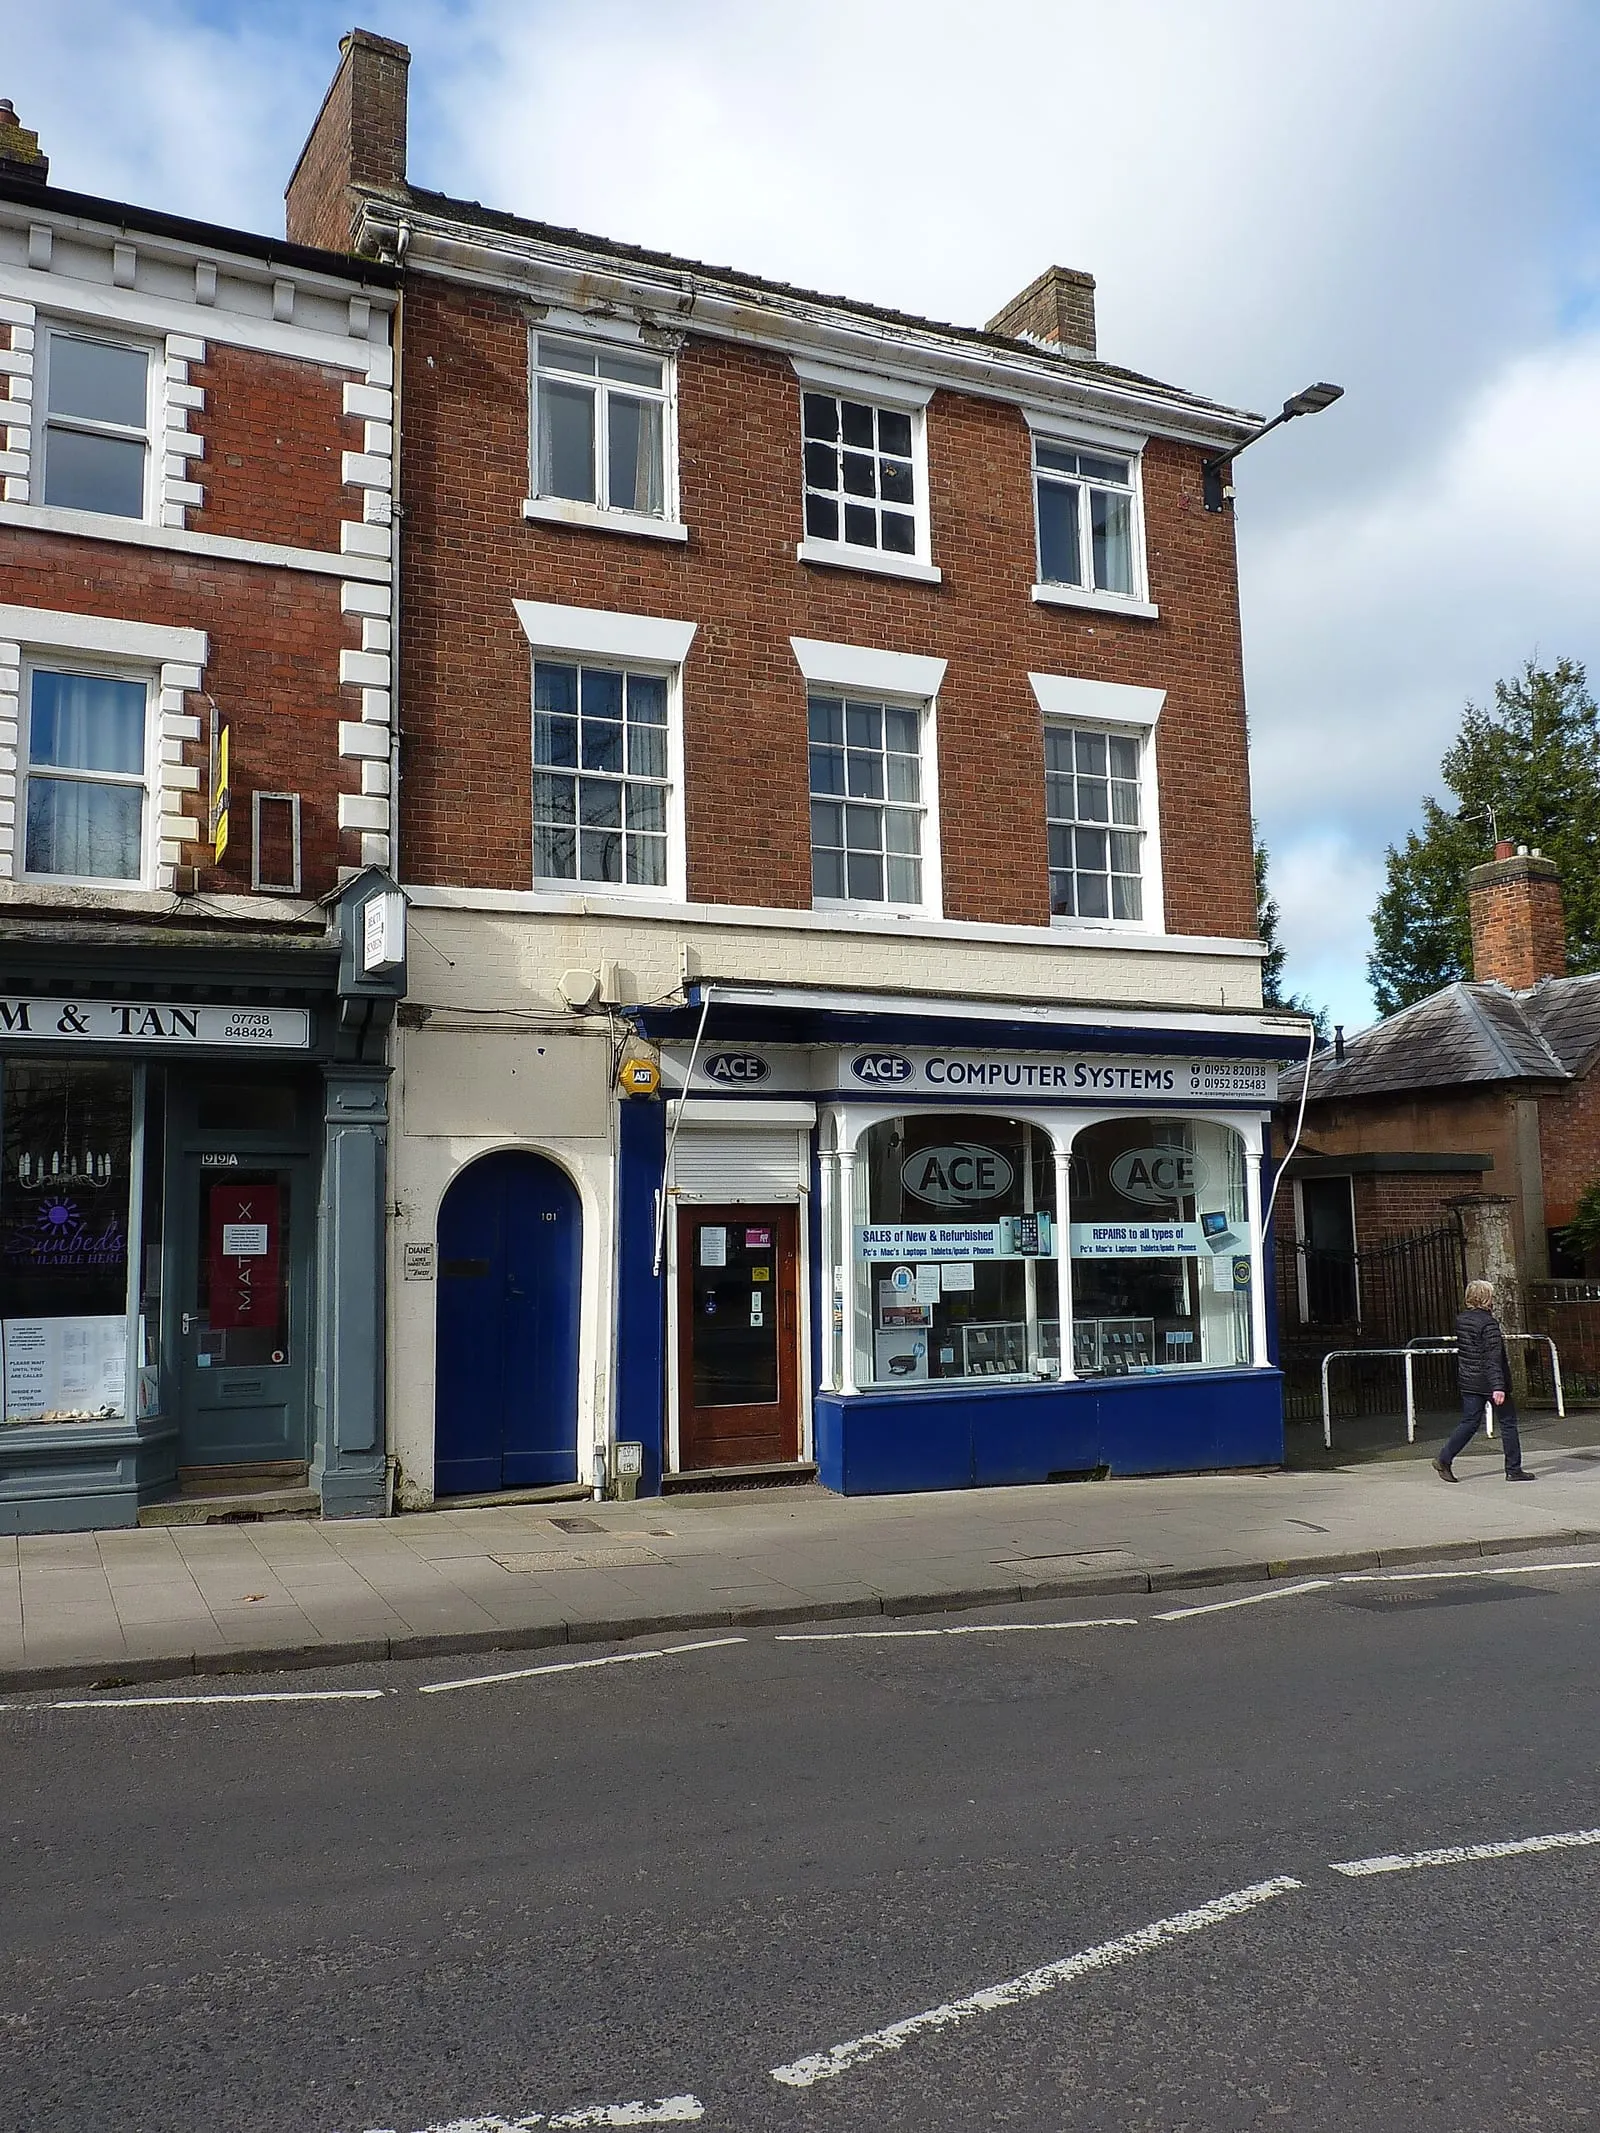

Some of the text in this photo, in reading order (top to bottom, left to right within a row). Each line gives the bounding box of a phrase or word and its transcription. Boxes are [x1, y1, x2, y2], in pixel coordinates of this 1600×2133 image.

[57, 1004, 90, 1033] &
[112, 1007, 201, 1038] TAN
[231, 1013, 270, 1025] 07738
[225, 1027, 273, 1039] 848424
[713, 1058, 758, 1077] ACE
[860, 1057, 1174, 1090] ACE COMPUTER SYSTEMS
[1204, 1065, 1230, 1075] 01952
[1233, 1066, 1266, 1076] 820138
[634, 1071, 652, 1082] ADT
[1204, 1078, 1230, 1088] 01952
[1233, 1079, 1266, 1089] 825483
[202, 1153, 238, 1165] 99A
[919, 1156, 996, 1191] ACE
[1126, 1157, 1195, 1190] ACE
[541, 1212, 557, 1221] 101
[5, 1221, 126, 1253] Sunbeds
[863, 1230, 994, 1242] SALES of New & Refurbished
[1093, 1228, 1183, 1240] REPAIRS to all types of
[881, 1248, 899, 1256] Mac's
[903, 1248, 927, 1257] Laptops
[973, 1247, 994, 1255] Phones
[1116, 1245, 1137, 1253] Laptops
[88, 1254, 122, 1264] HERE
[238, 1202, 252, 1310] MATX
